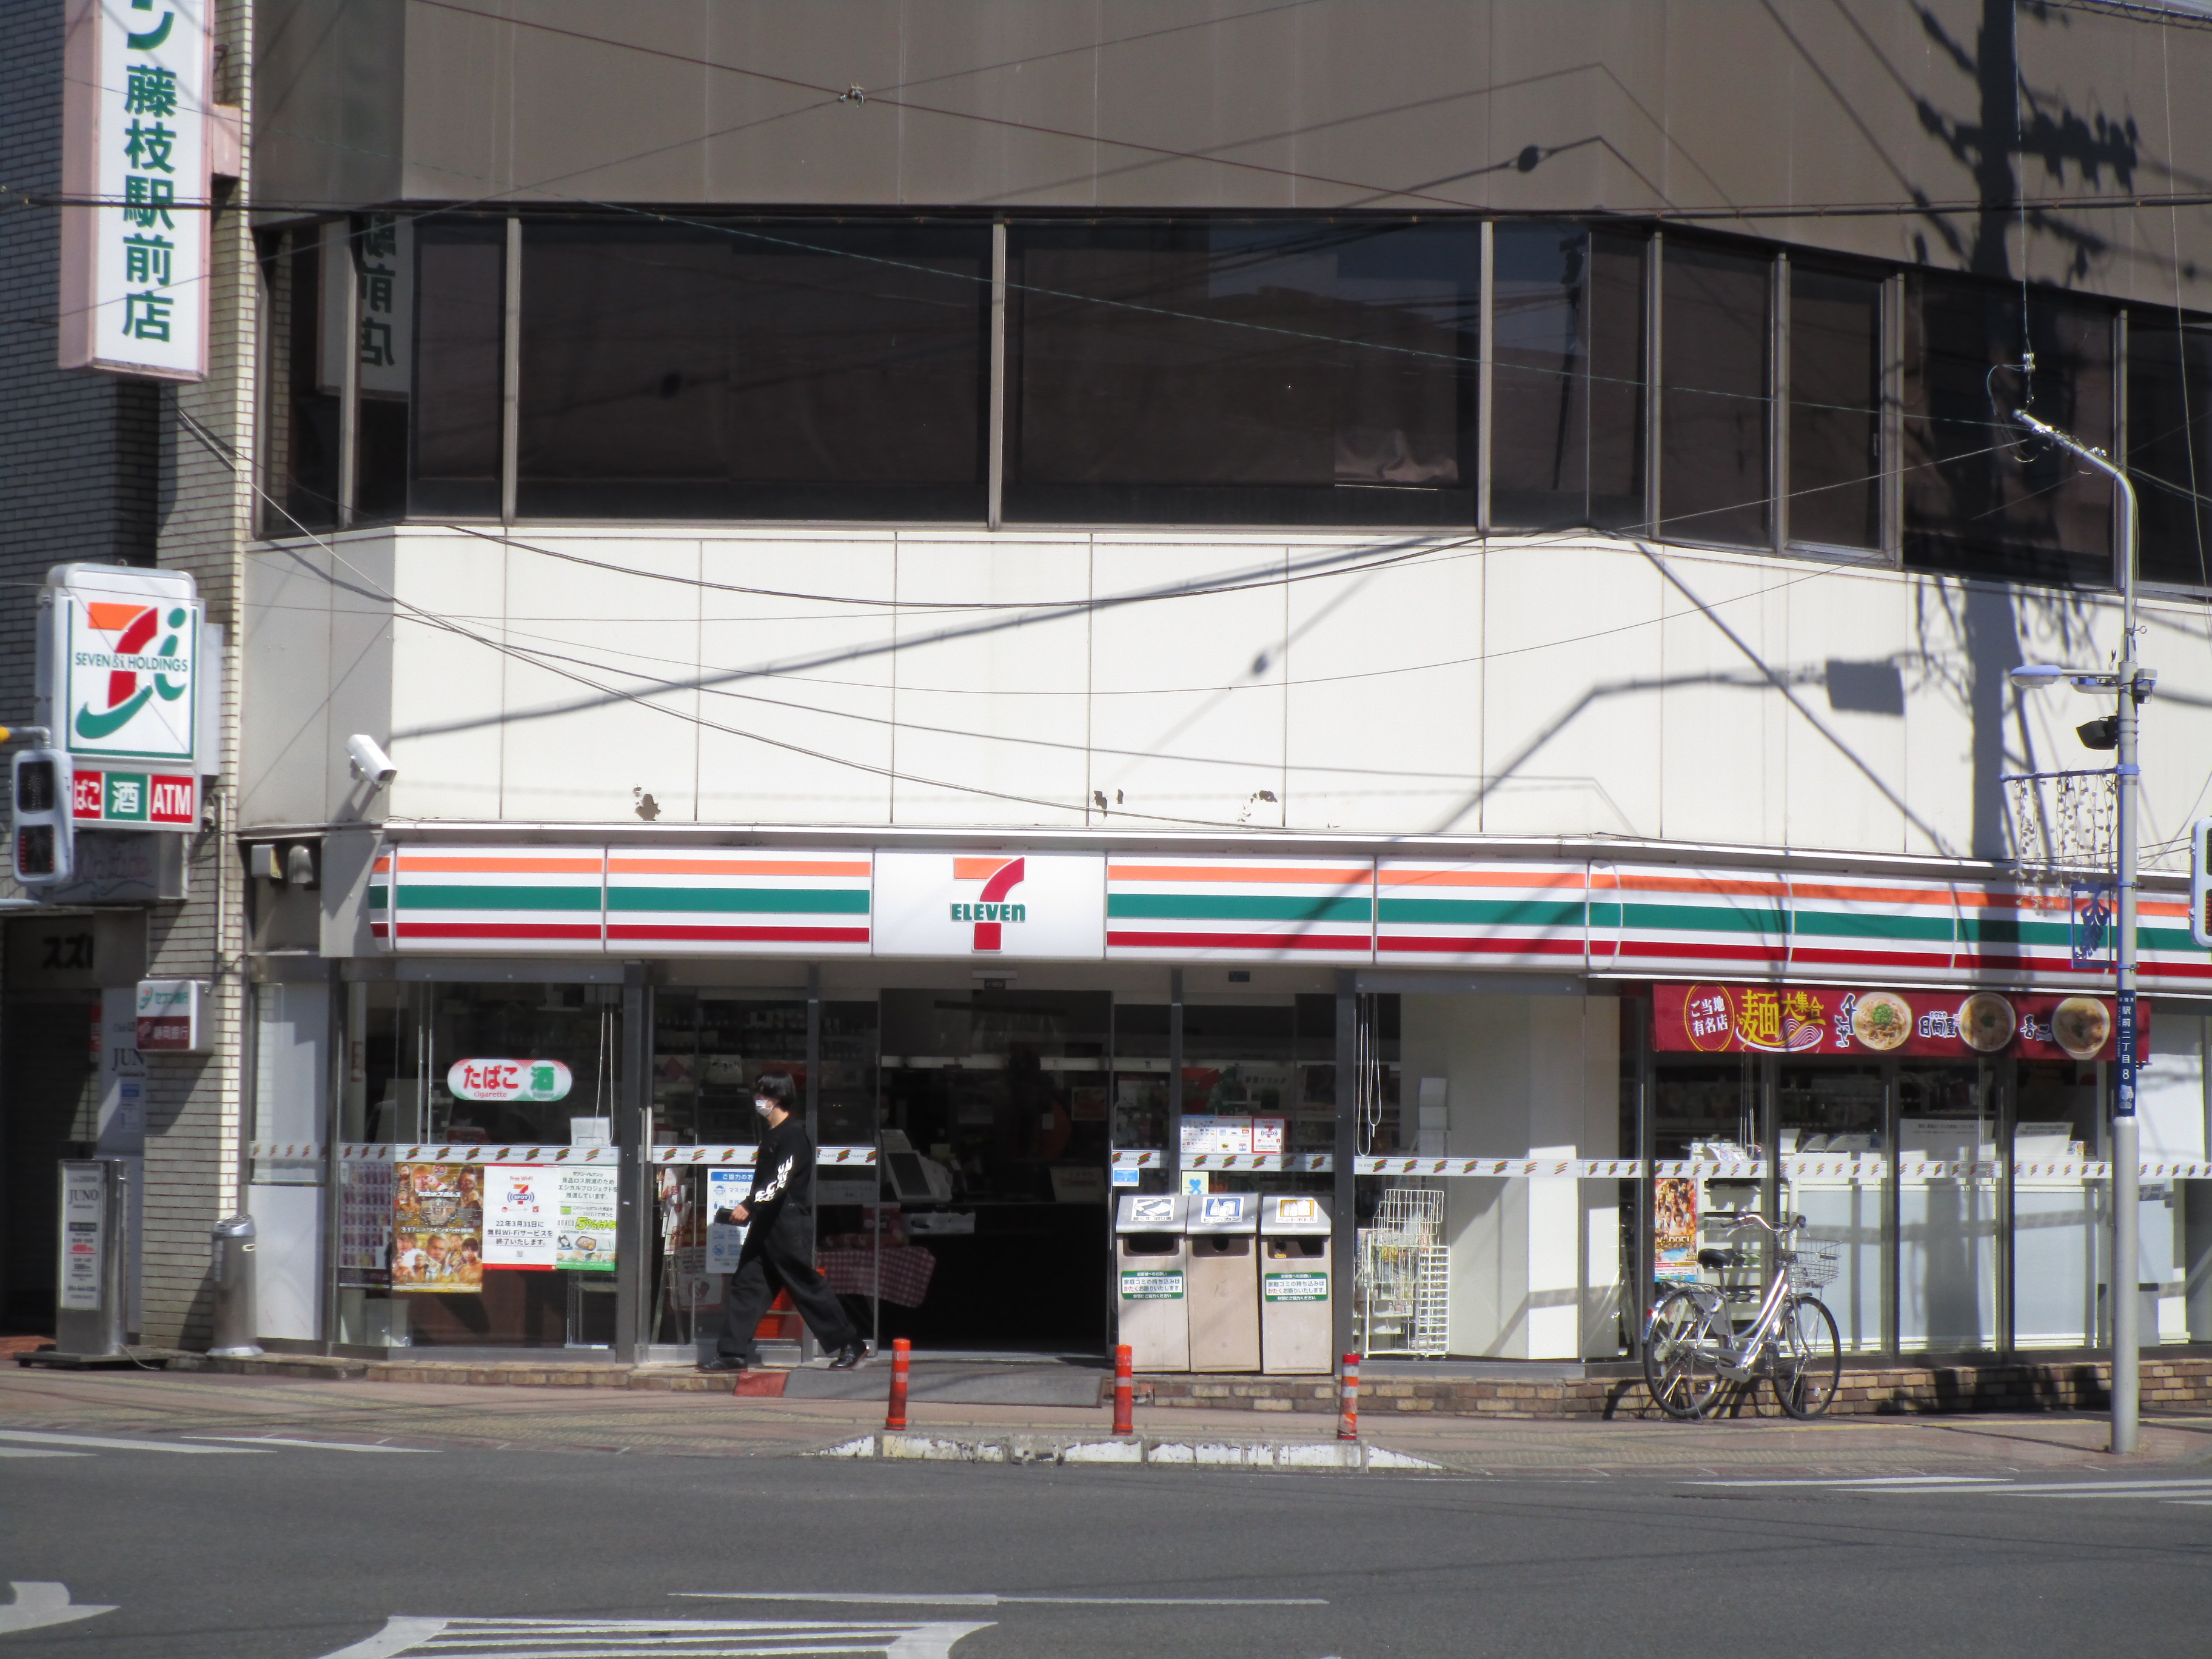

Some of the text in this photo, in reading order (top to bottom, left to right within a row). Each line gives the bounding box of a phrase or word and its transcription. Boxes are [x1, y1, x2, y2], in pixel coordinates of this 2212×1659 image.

[122, 65, 177, 343] 藤枝駅前店
[128, 656, 189, 672] HOLDINGS
[73, 779, 101, 811] ばこ
[112, 780, 140, 814] 酒
[152, 783, 192, 816] ATM
[42, 933, 93, 969] スズ
[1690, 995, 1726, 1018] ご当地
[1692, 1014, 1729, 1037] 有名店
[463, 1065, 519, 1090] たばこ
[530, 1066, 555, 1091] 酒
[68, 1188, 100, 1204] JUNO
